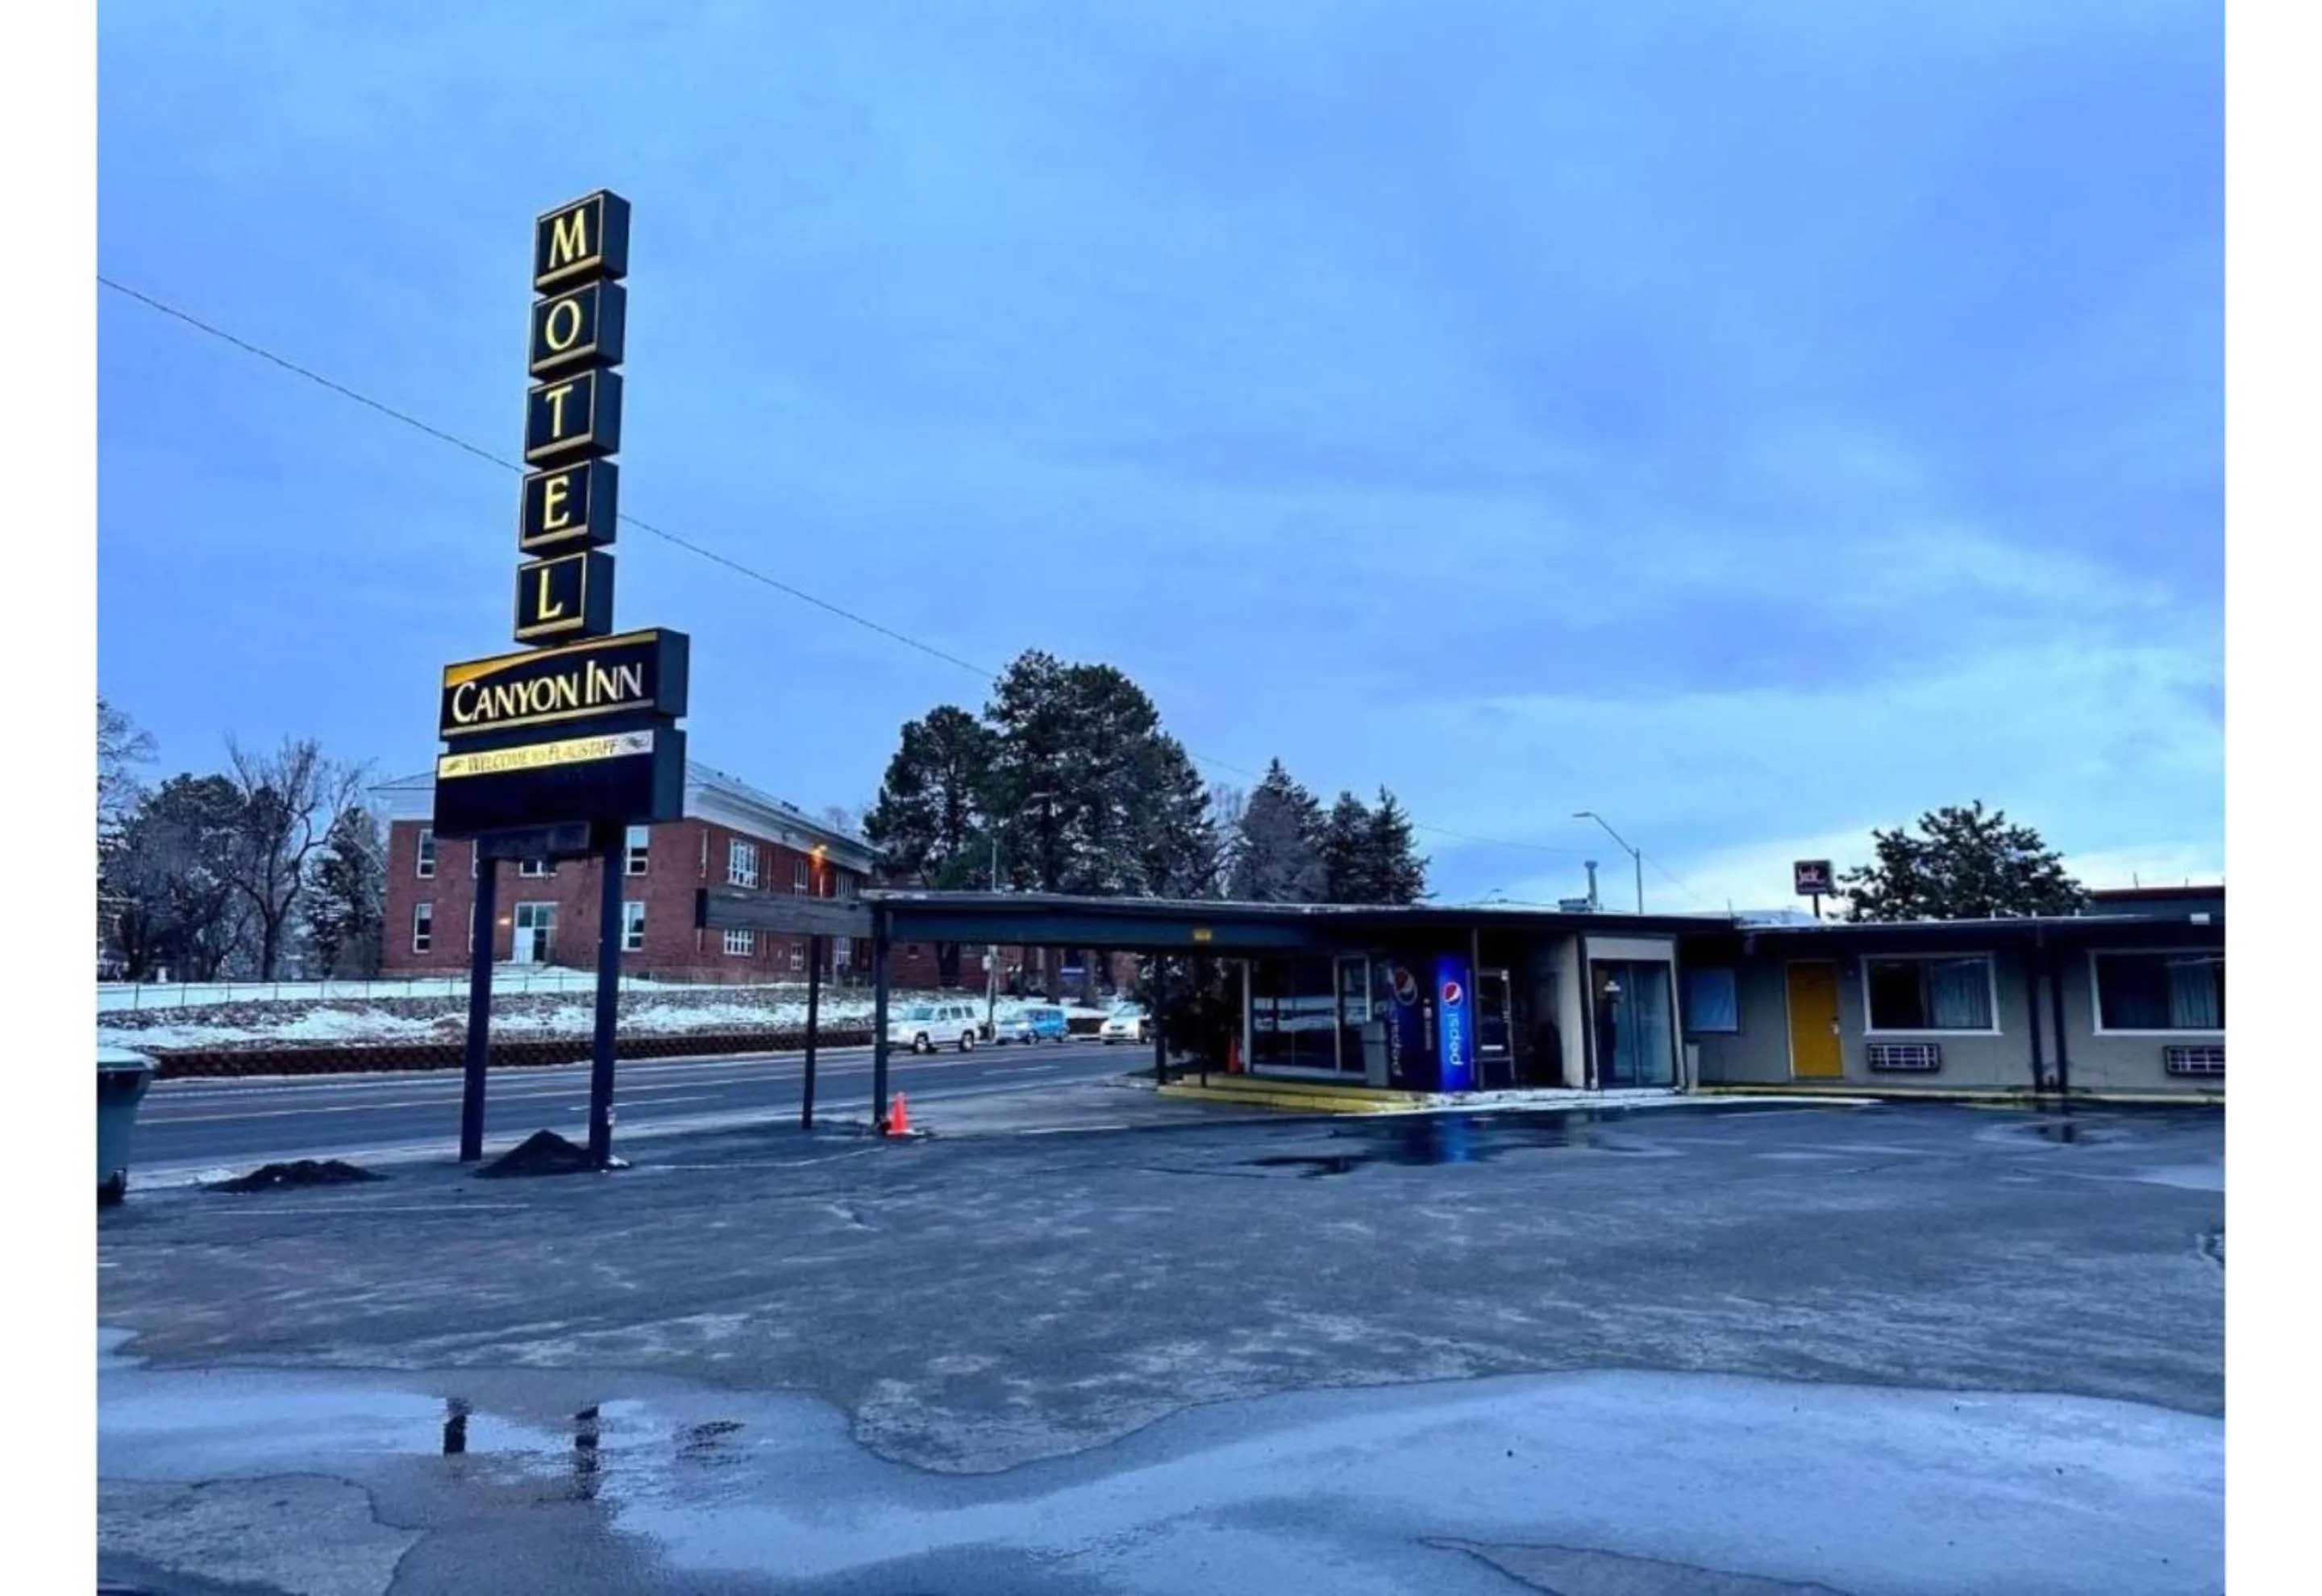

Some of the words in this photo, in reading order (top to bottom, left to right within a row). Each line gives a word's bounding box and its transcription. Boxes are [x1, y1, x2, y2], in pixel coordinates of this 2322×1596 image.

[538, 207, 587, 621] MOTEL
[452, 671, 578, 723] CANYON
[585, 660, 643, 704] INN
[1446, 1013, 1463, 1066] pepsi
